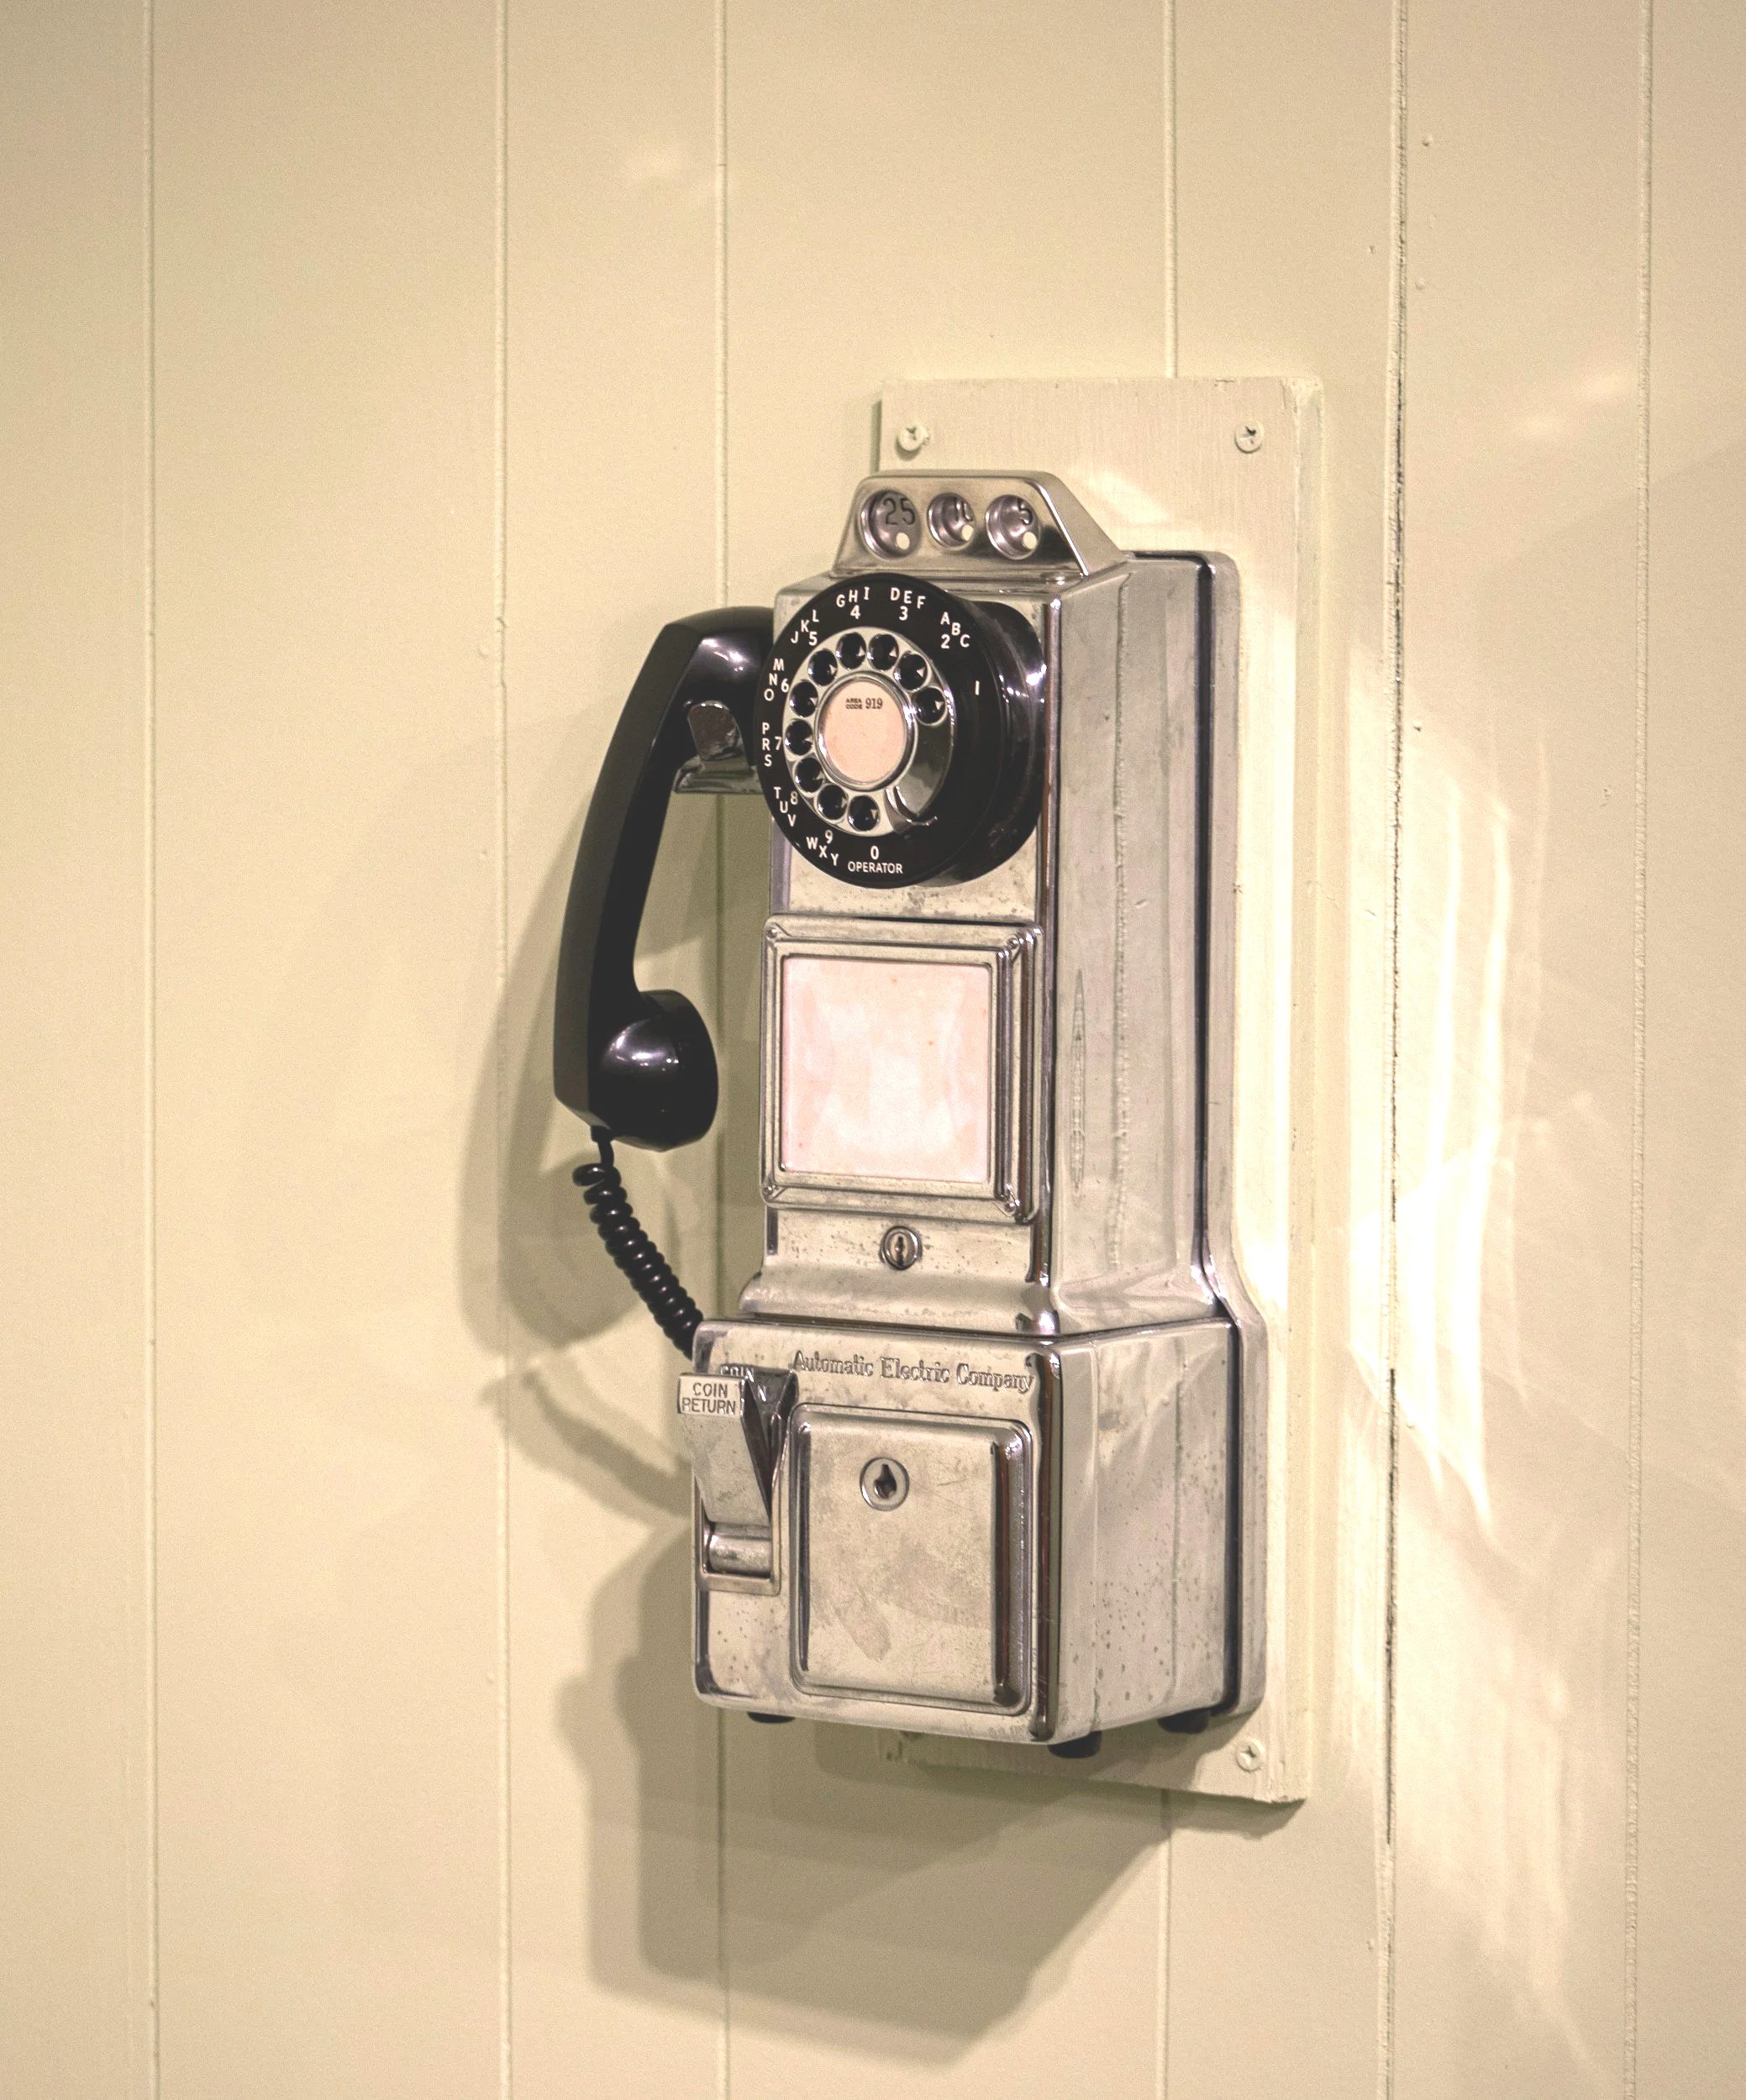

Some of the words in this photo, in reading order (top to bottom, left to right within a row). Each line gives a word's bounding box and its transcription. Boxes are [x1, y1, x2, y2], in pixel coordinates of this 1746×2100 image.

[882, 498, 915, 525] 25
[850, 606, 860, 619] 4
[899, 606, 907, 621] 3
[807, 631, 818, 646] 5
[941, 634, 950, 648] 2
[781, 679, 789, 694] 6
[865, 698, 883, 709] 919
[775, 737, 781, 750] 7
[791, 791, 797, 805] 8
[825, 830, 833, 843] 9
[848, 861, 902, 874] OPERATOR
[791, 1349, 874, 1377] Automatic
[881, 1356, 949, 1383] Electric
[956, 1362, 1034, 1394] Company
[692, 1383, 728, 1398] COIN
[682, 1397, 736, 1415] RETURN
